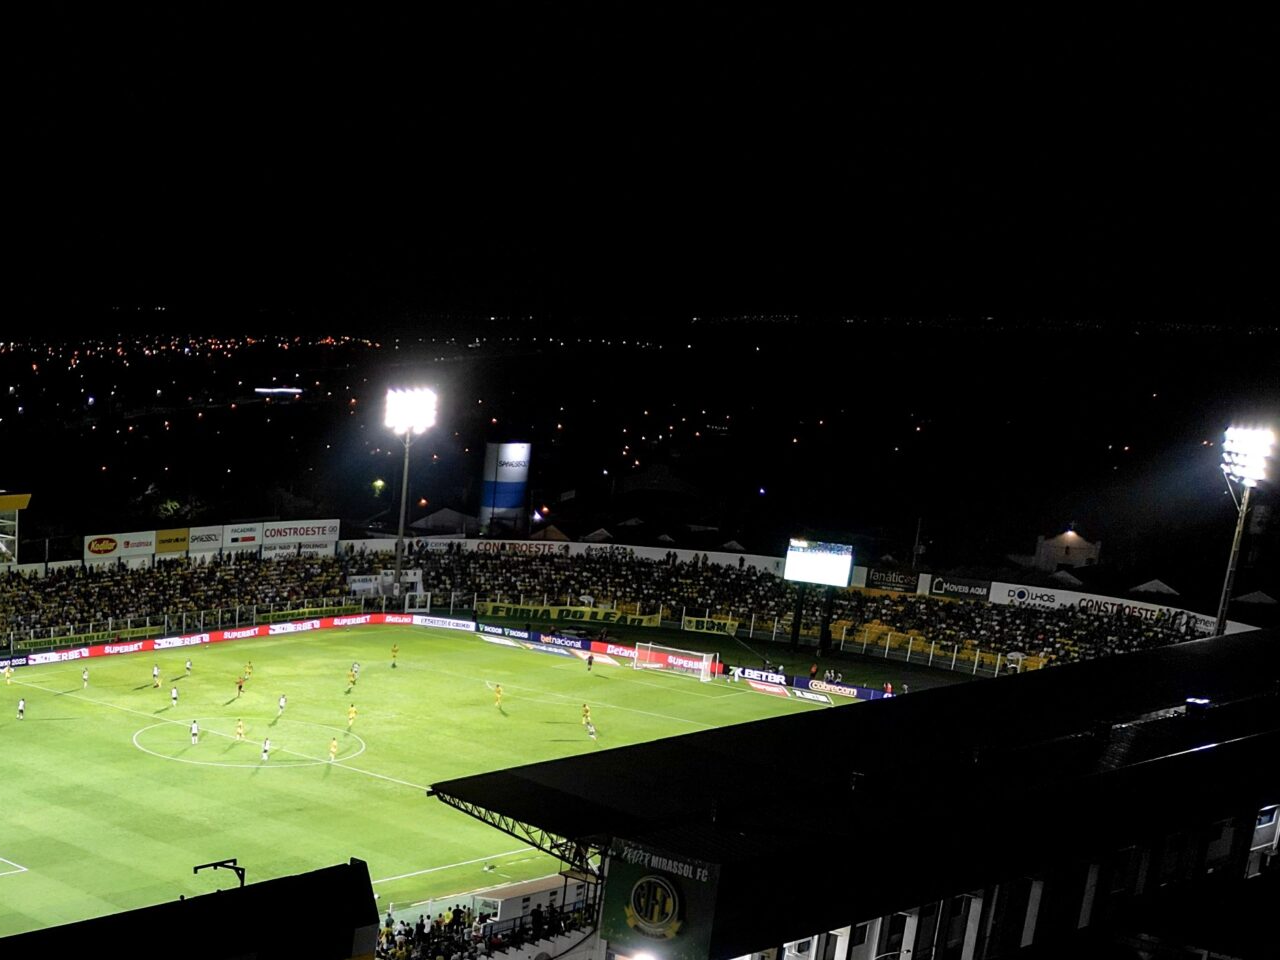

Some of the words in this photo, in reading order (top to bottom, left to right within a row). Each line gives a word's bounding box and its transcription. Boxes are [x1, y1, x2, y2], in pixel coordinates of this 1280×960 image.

[264, 526, 327, 538] CONSTROESTE
[477, 541, 555, 553] CONTROESTE
[540, 634, 582, 649] betnacional
[607, 644, 639, 658] Betano
[809, 680, 858, 698] cobrecom
[651, 855, 694, 879] MIRASSOL
[696, 867, 710, 882] FC
